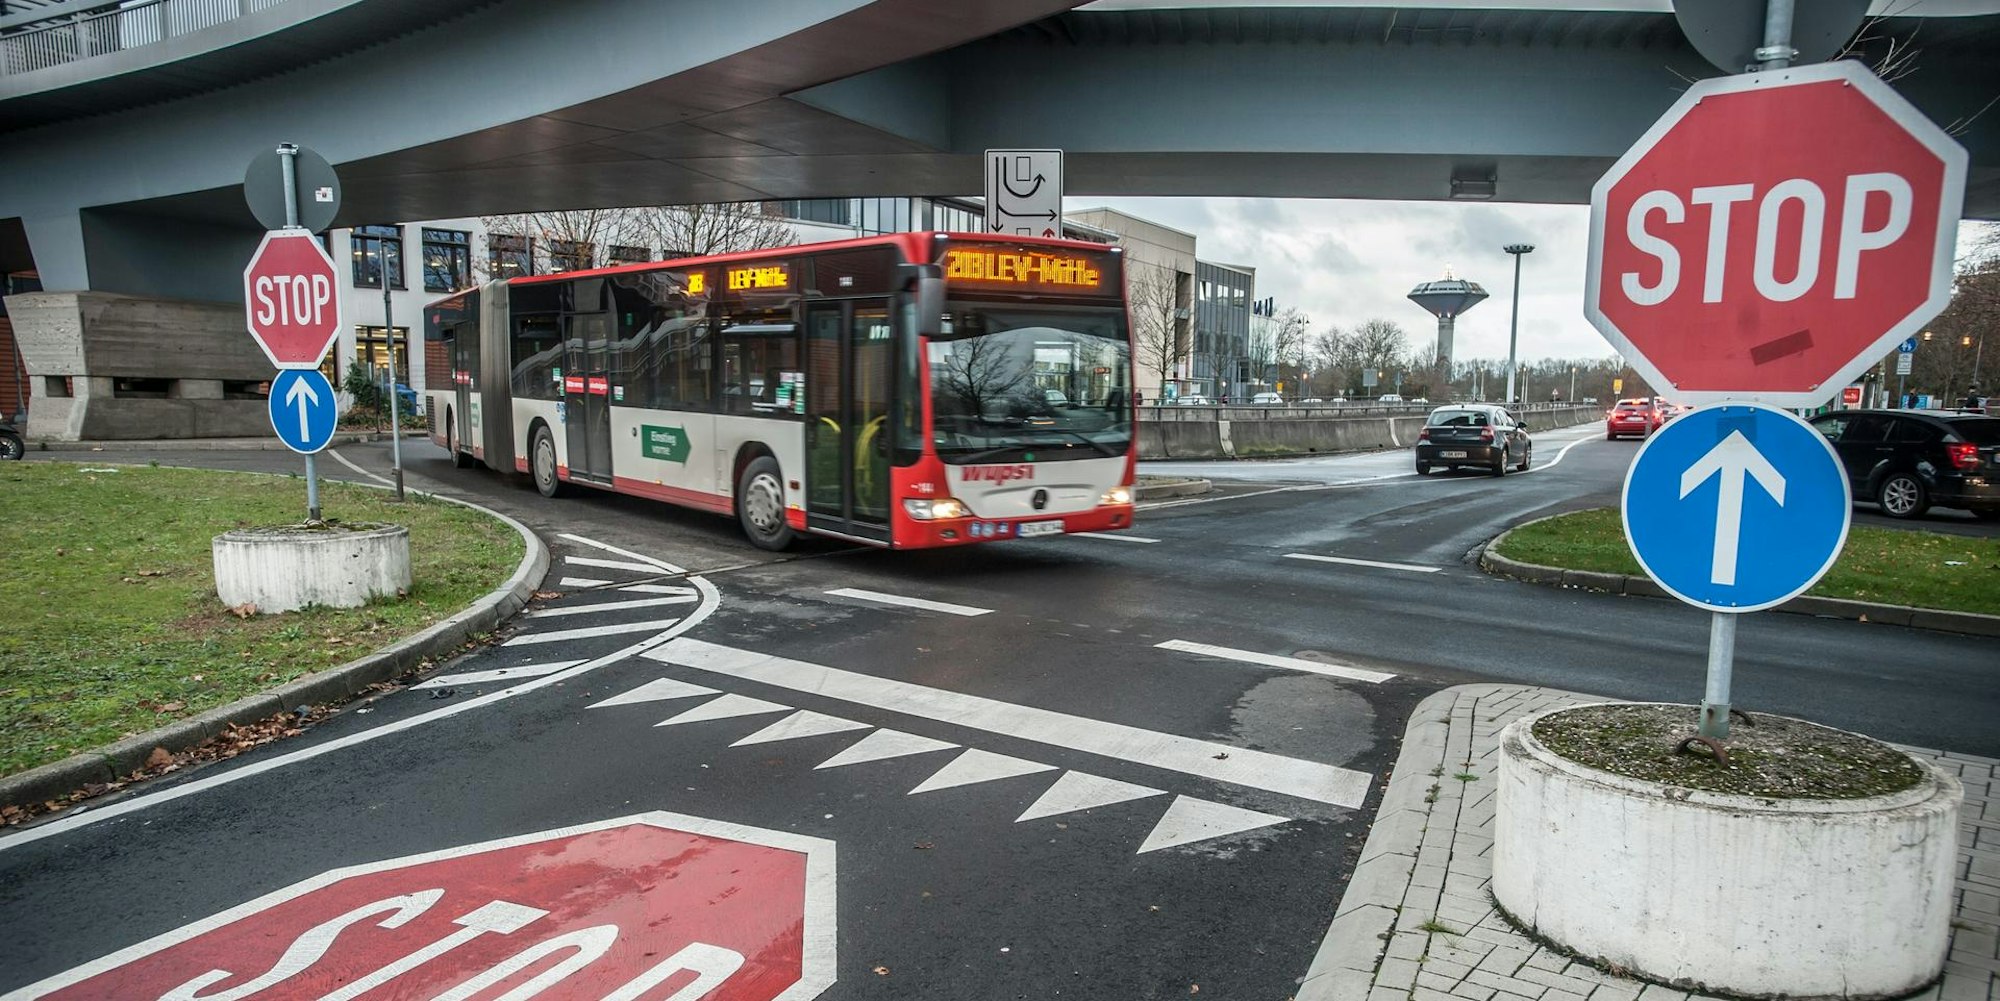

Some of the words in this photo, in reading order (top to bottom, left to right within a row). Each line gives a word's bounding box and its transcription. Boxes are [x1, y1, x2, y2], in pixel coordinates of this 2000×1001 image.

[1620, 172, 1914, 306] STOP
[985, 253, 1098, 285] LEV-Mitte
[256, 273, 331, 327] STOP
